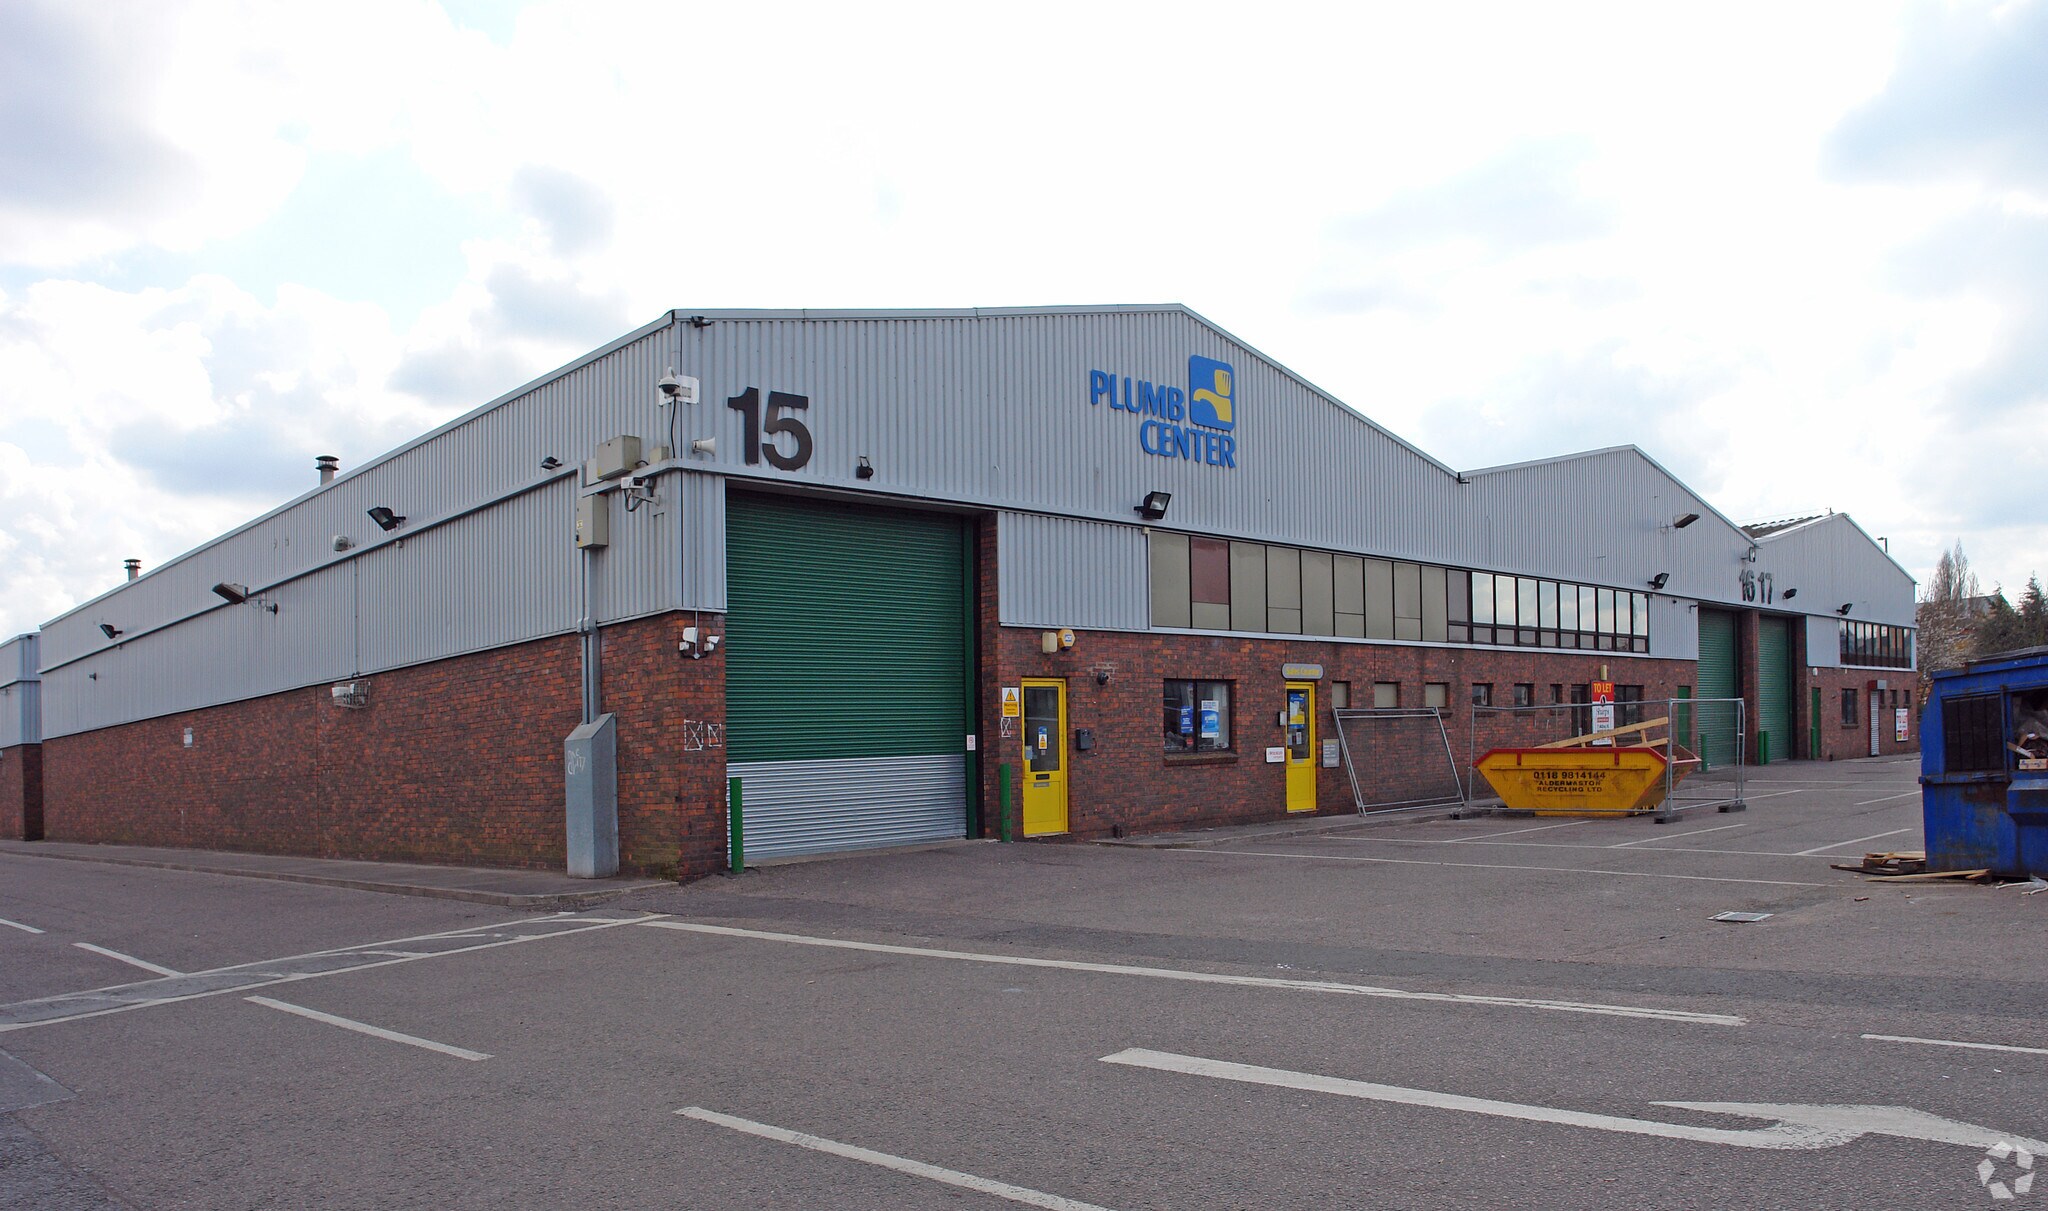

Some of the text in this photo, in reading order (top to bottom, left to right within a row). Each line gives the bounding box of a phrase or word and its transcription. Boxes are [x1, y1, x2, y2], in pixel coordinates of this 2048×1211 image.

[1090, 368, 1185, 421] PLUMB
[728, 386, 813, 471] 15
[1140, 419, 1236, 468] CENTER
[1739, 569, 1772, 604] 16 17
[1593, 683, 1612, 693] TO LET
[1533, 771, 1606, 779] 0118 9814144
